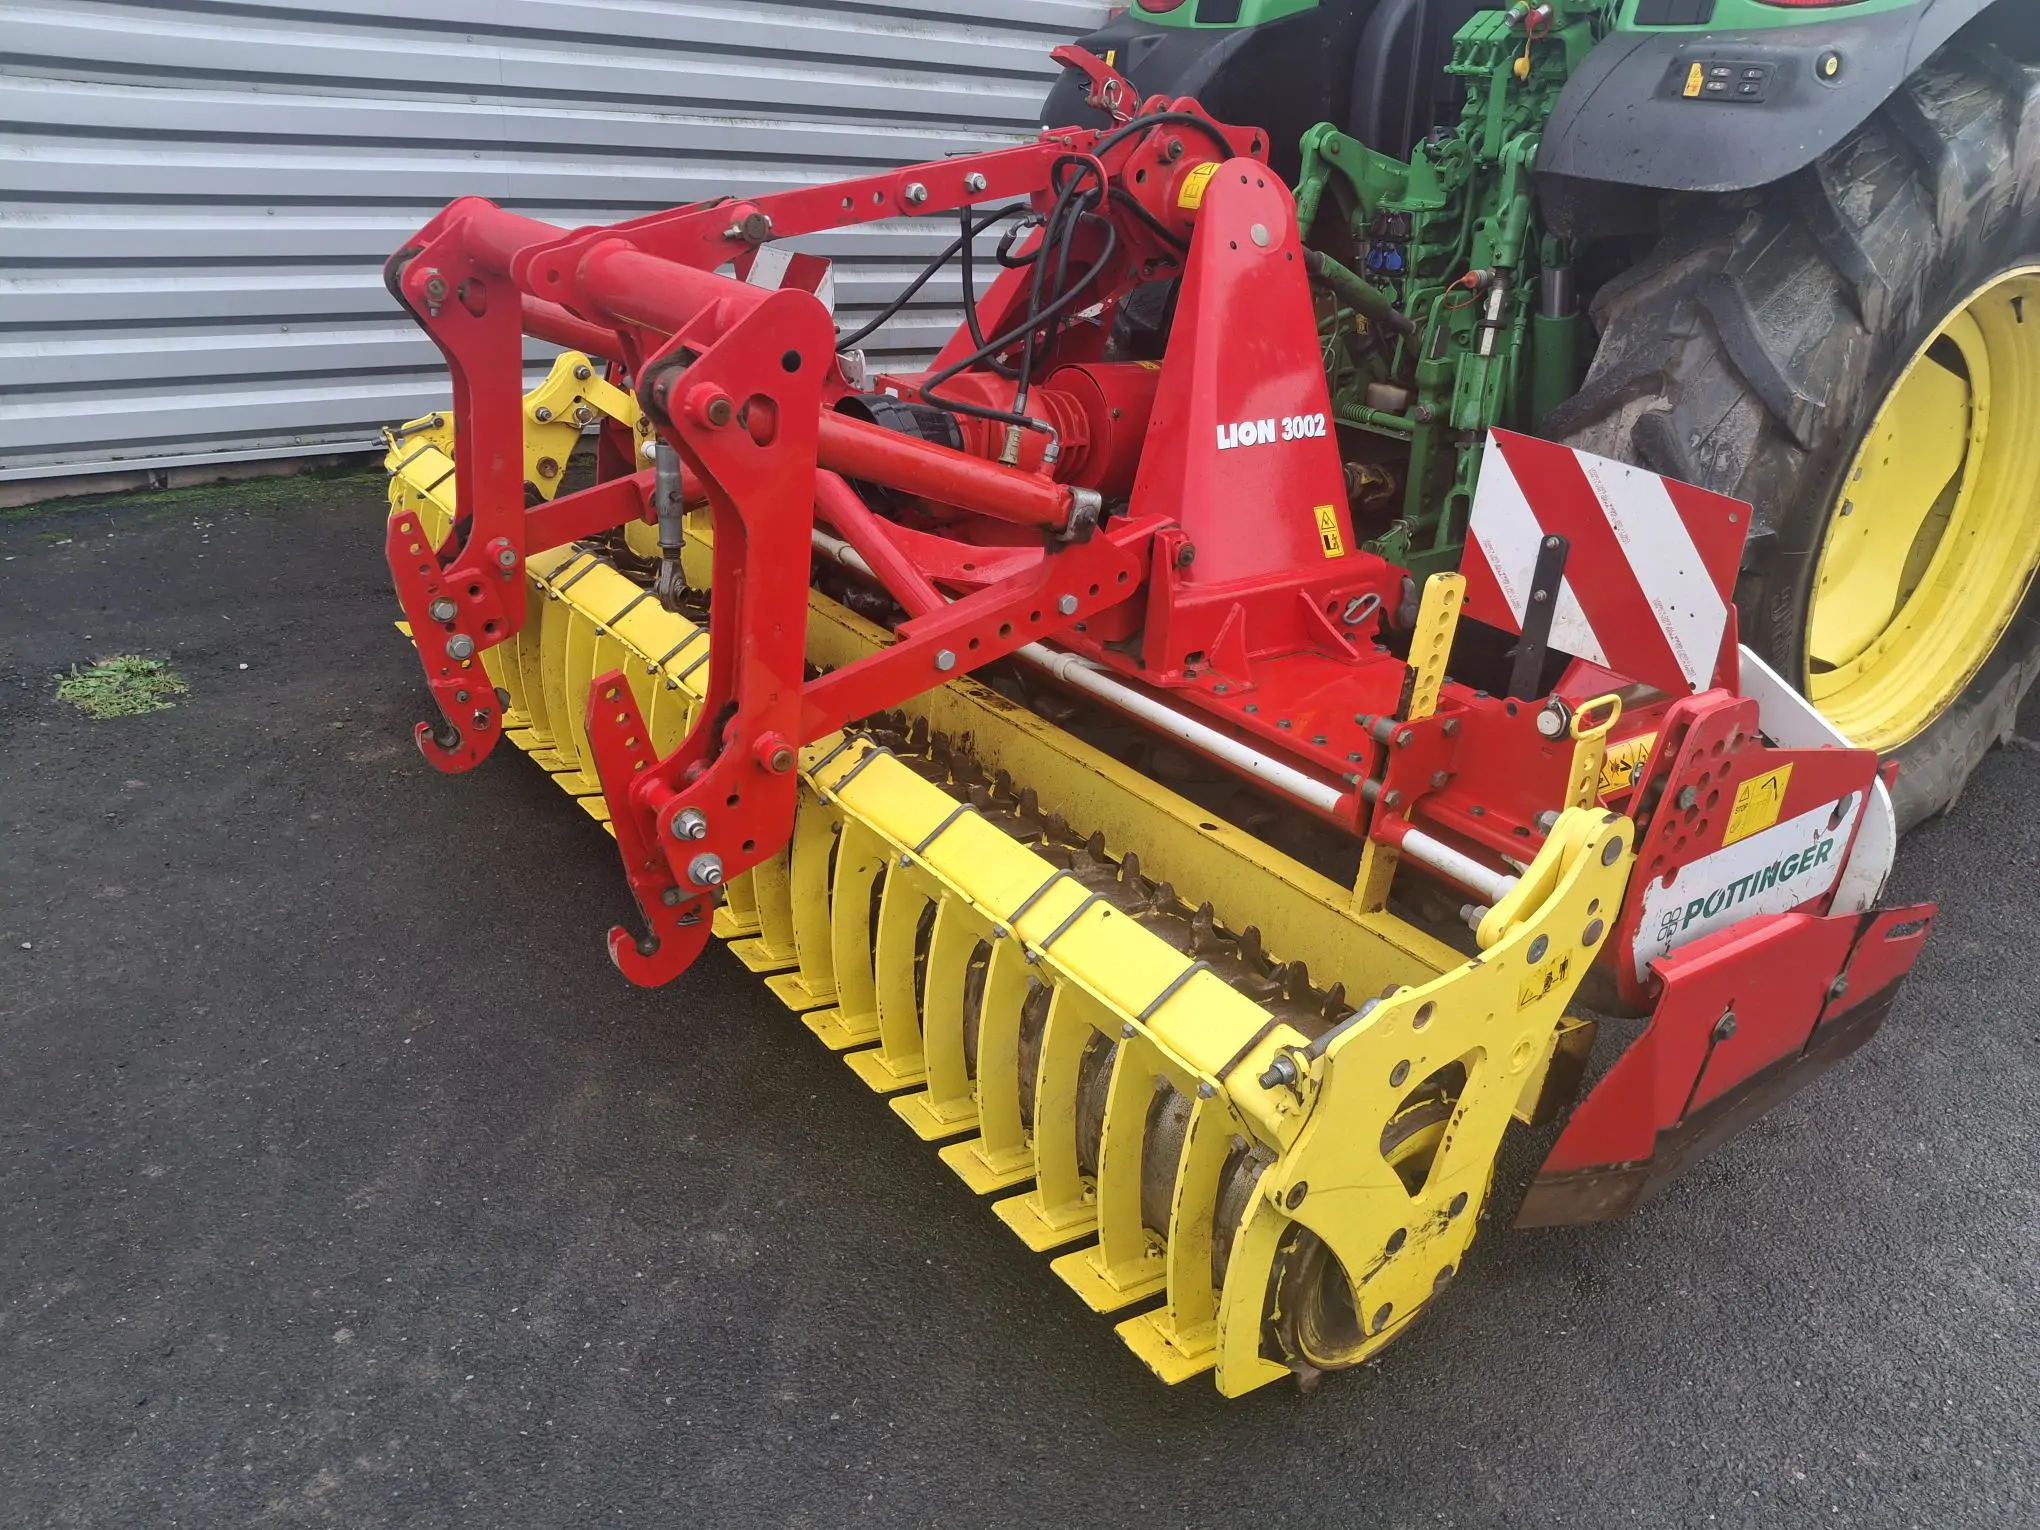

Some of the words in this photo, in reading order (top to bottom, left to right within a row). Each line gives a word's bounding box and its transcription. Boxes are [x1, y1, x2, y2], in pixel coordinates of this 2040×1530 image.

[1216, 418, 1277, 450] LION
[1281, 413, 1327, 441] 3002
[1681, 838, 1834, 930] PÖTTINGER
